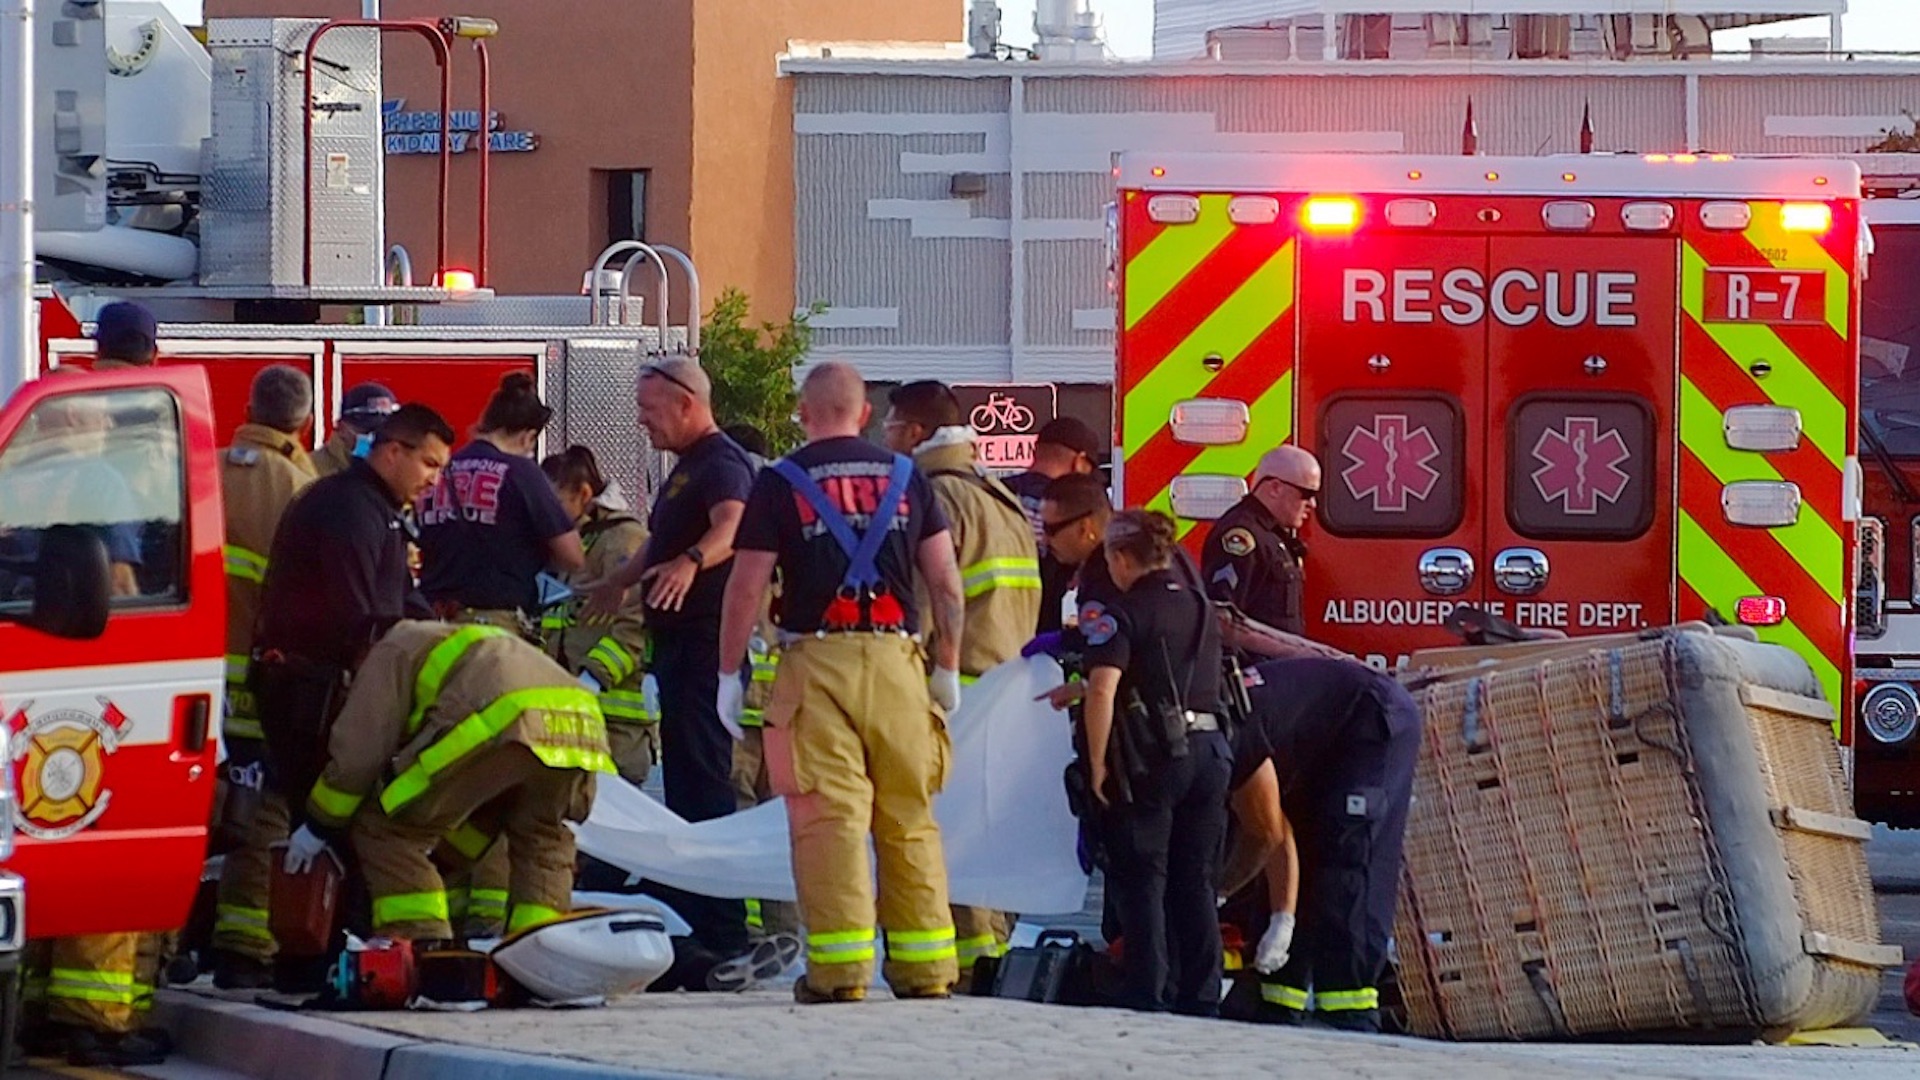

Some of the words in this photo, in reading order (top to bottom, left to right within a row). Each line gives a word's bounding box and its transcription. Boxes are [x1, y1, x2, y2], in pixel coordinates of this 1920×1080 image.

[386, 110, 498, 132] FRESNIU
[386, 133, 463, 153] KIDNY
[476, 131, 533, 151] ARE
[1342, 268, 1637, 326] RESCUE
[1727, 273, 1801, 320] R-7
[1005, 441, 1037, 461] LAN
[1323, 600, 1505, 626] ALBUQUERE
[1515, 602, 1569, 626] FIRE
[1579, 603, 1648, 627] DEPT.
